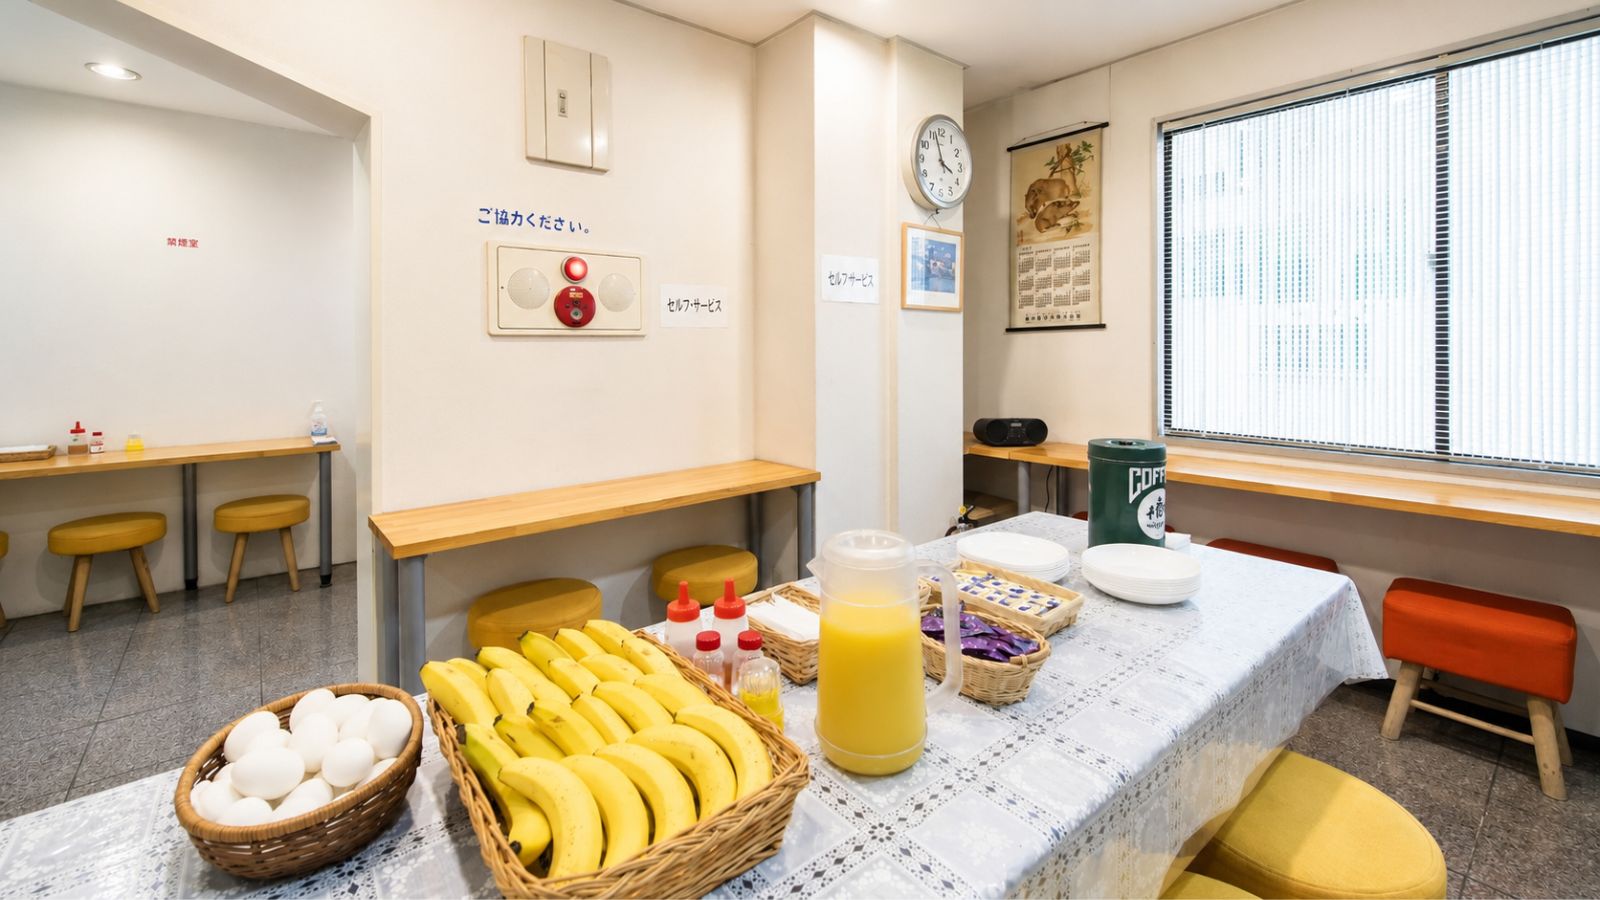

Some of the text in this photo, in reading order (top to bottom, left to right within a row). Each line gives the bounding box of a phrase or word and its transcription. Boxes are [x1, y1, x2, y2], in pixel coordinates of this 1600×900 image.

[929, 130, 936, 141] 11
[937, 128, 945, 138] 12
[920, 140, 930, 150] 10
[953, 148, 960, 158] 2
[919, 154, 925, 163] 9
[957, 162, 963, 173] 3
[921, 169, 928, 178] 8
[929, 182, 935, 191] 7
[478, 207, 590, 234] ご協力ください。
[827, 270, 875, 288] セルフサービス
[1128, 465, 1167, 504] COFF
